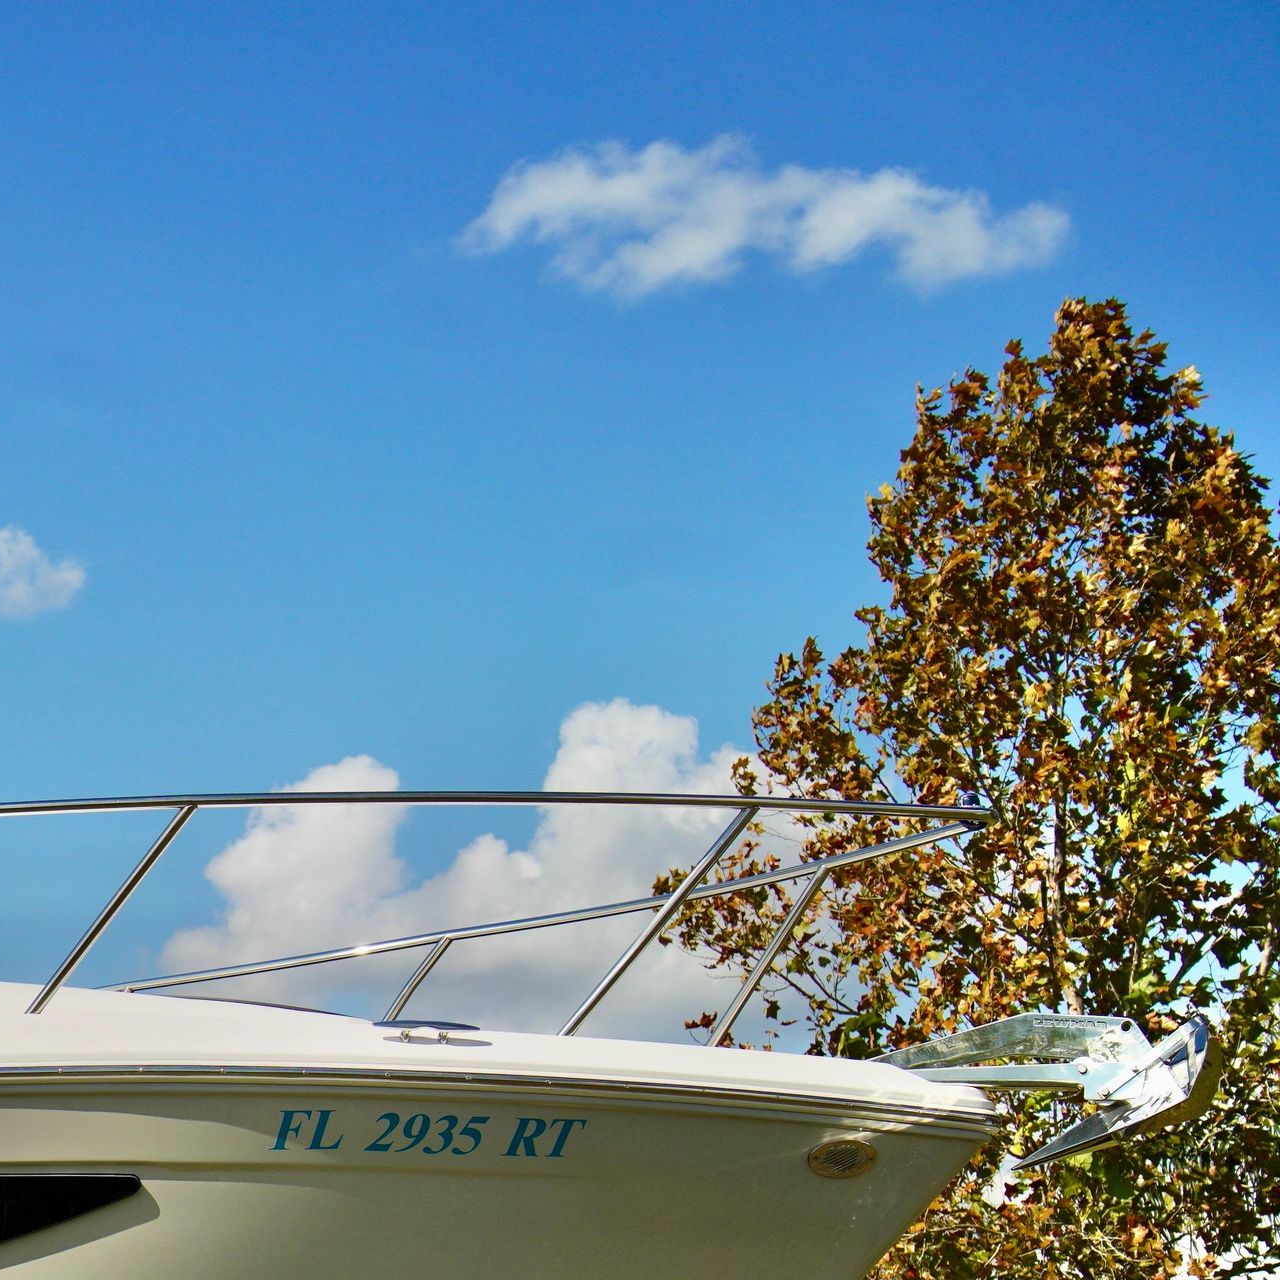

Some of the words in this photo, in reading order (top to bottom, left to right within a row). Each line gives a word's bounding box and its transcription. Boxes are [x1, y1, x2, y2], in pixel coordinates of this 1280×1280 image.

[1032, 1018, 1108, 1029] LEWMAR
[268, 1109, 344, 1151] FL
[364, 1111, 490, 1156] 2935
[500, 1117, 587, 1158] RT
